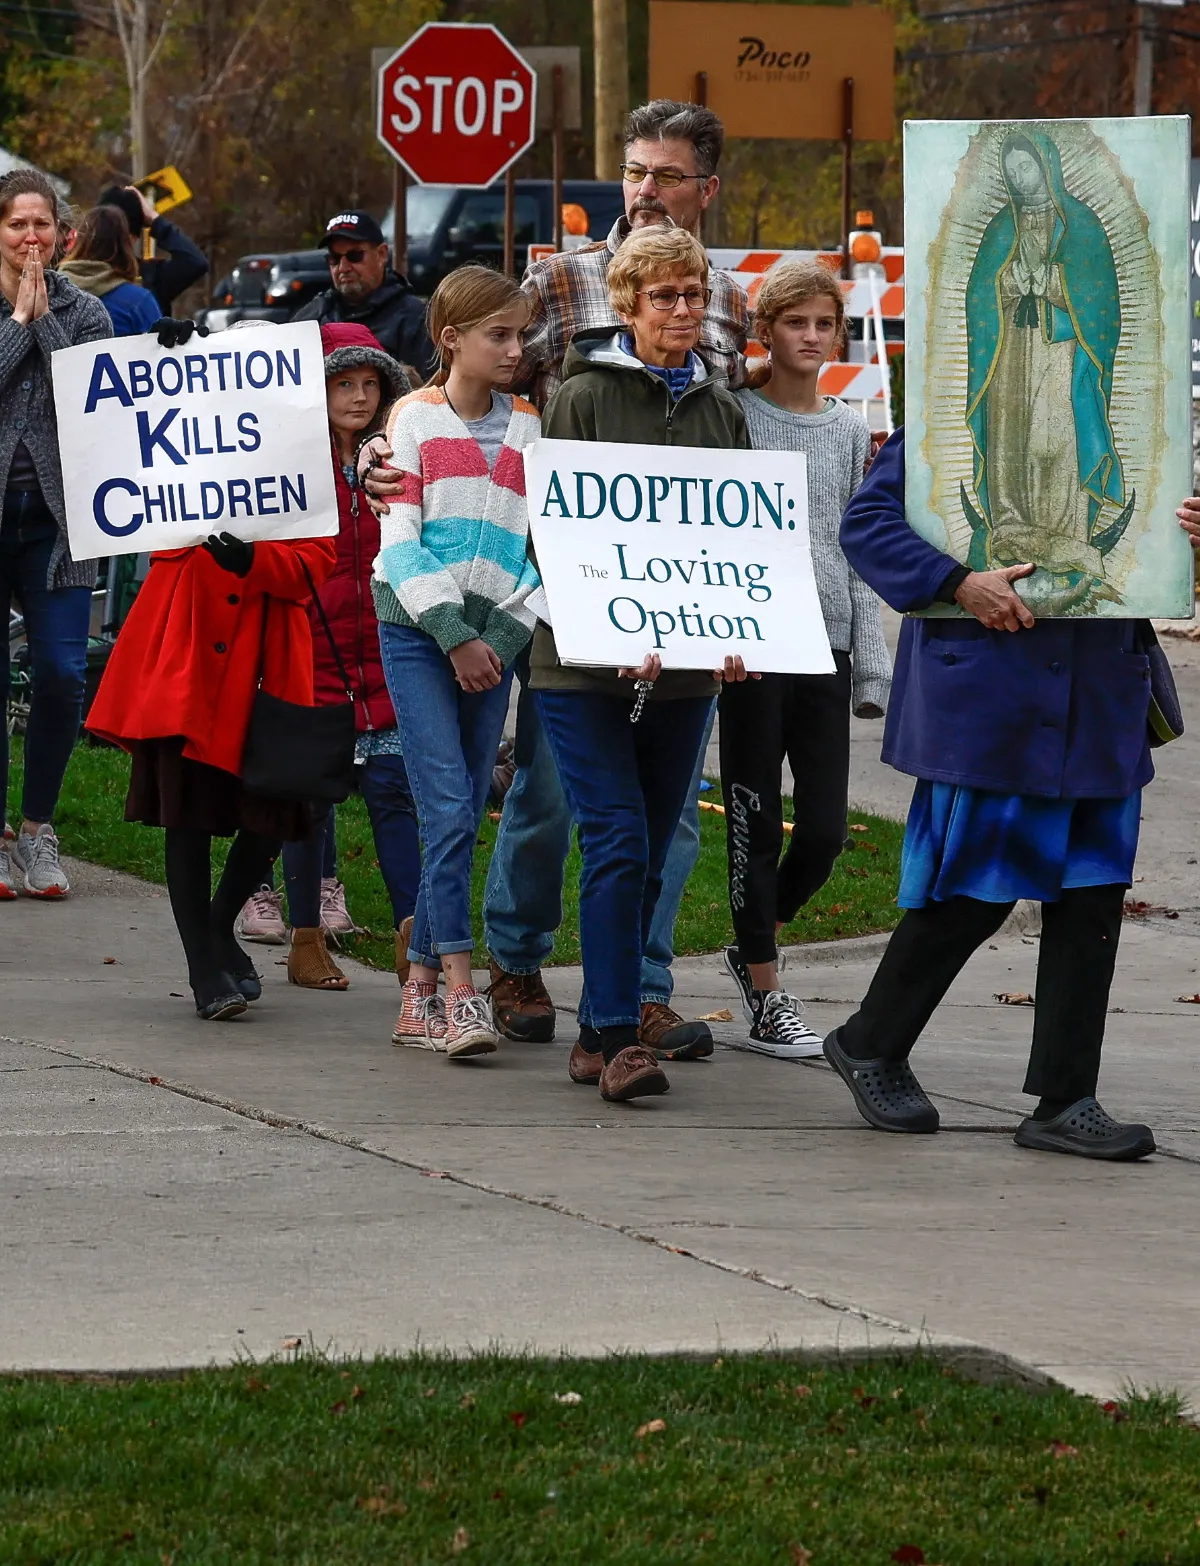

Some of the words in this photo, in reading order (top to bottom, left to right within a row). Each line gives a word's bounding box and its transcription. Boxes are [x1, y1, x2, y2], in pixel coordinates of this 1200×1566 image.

[737, 36, 811, 68] Poco
[390, 74, 524, 136] STOP
[84, 348, 302, 414] ABORTION
[136, 408, 262, 468] KILLS
[93, 473, 308, 537] CHILDREN
[541, 470, 796, 531] ADOPTION:
[579, 564, 609, 579] The
[612, 543, 772, 602] Loving
[608, 597, 766, 649] Option
[731, 783, 761, 911] Converse
